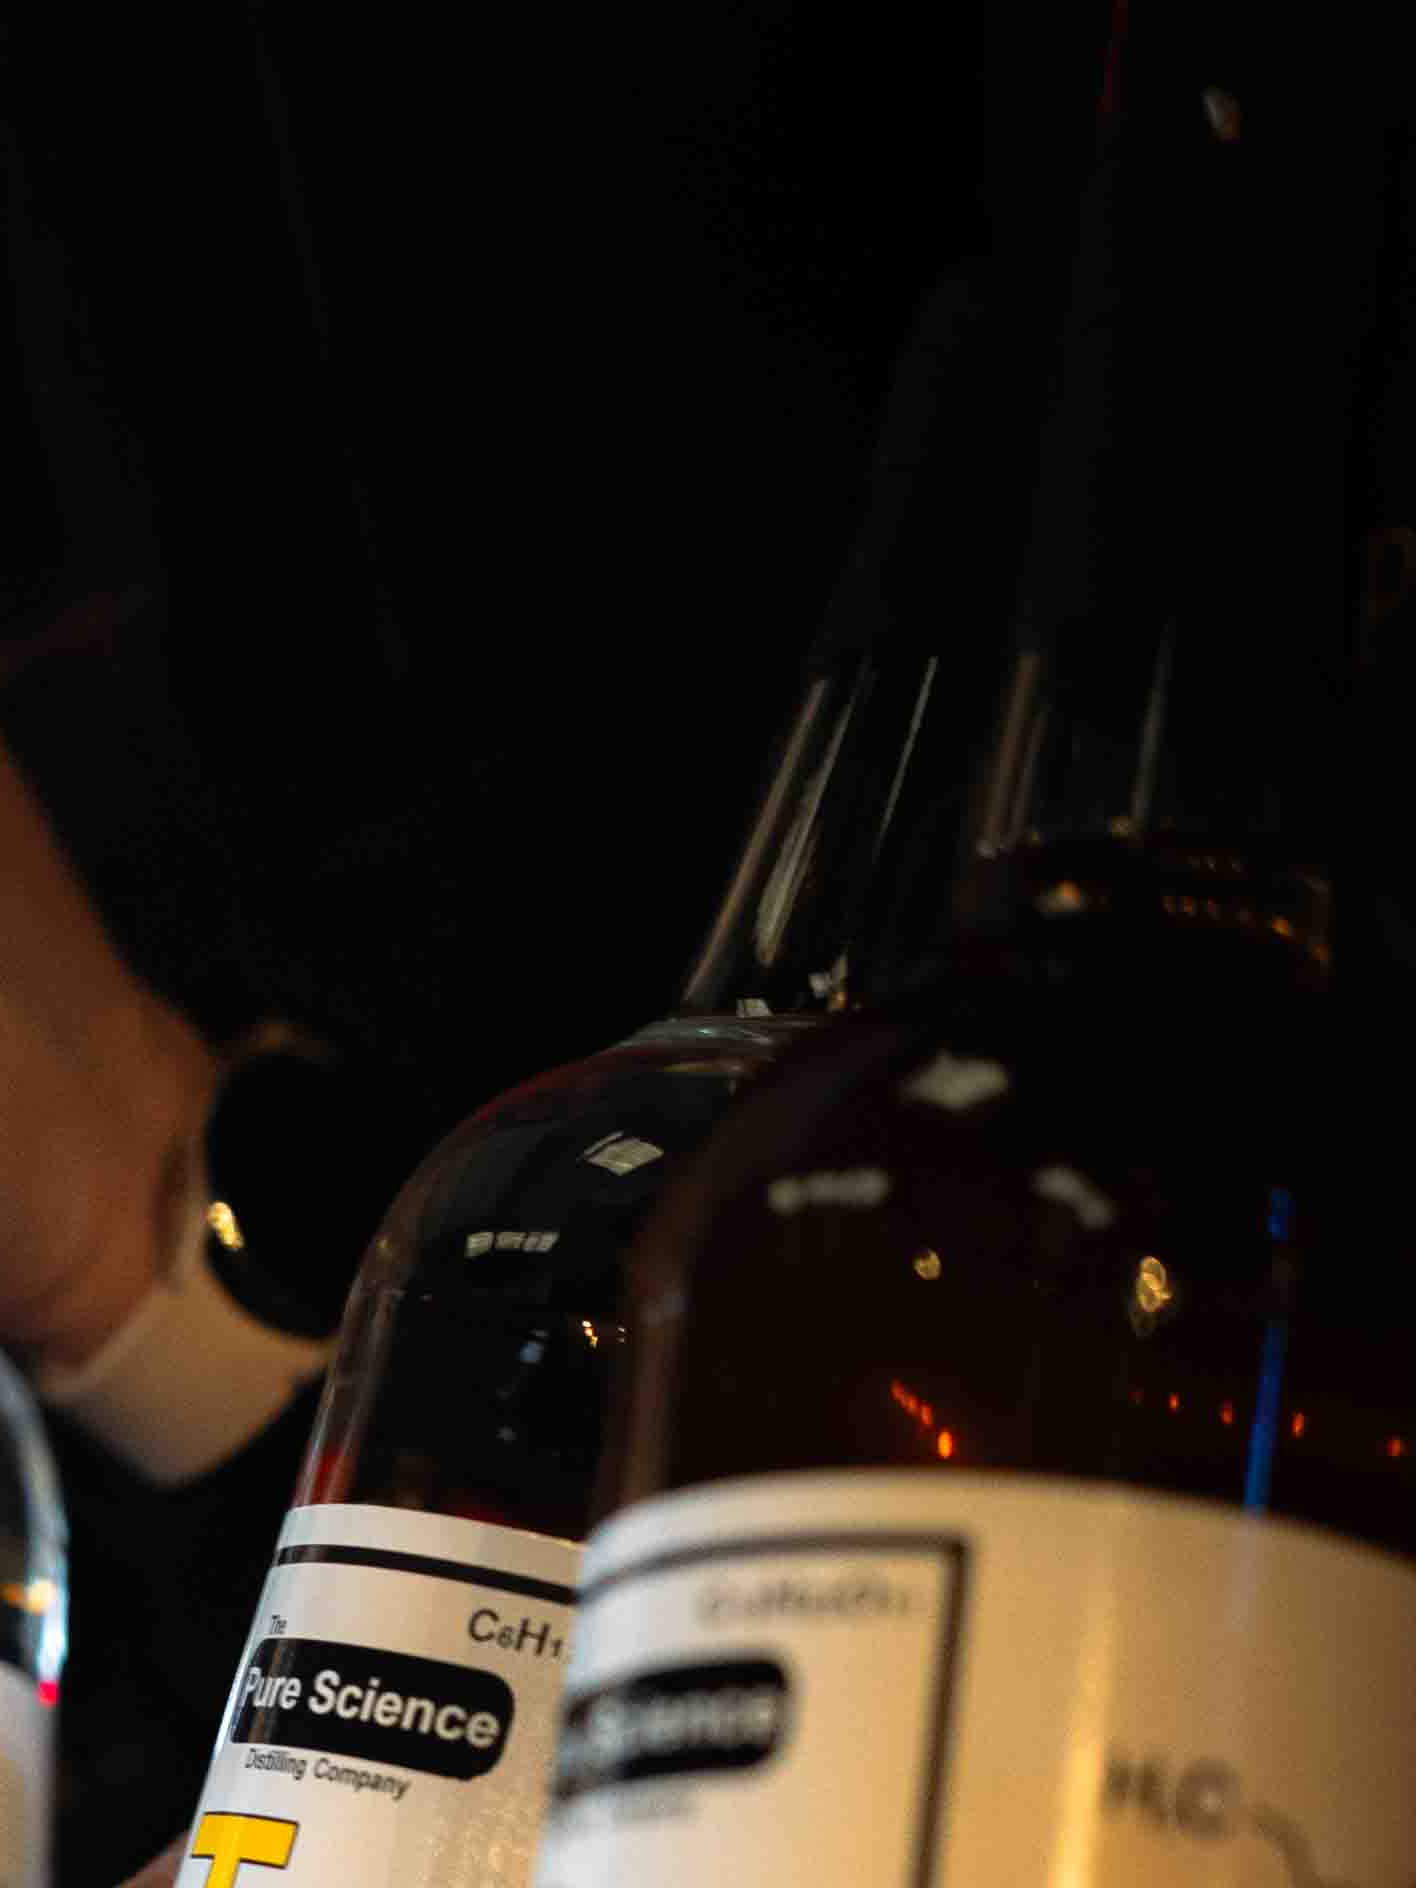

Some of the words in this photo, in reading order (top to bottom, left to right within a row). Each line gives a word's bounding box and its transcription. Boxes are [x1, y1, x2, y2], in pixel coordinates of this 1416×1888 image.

[242, 1665, 302, 1709] Pure
[307, 1668, 500, 1749] Science
[245, 1748, 308, 1781] Distilling
[313, 1757, 412, 1801] Company
